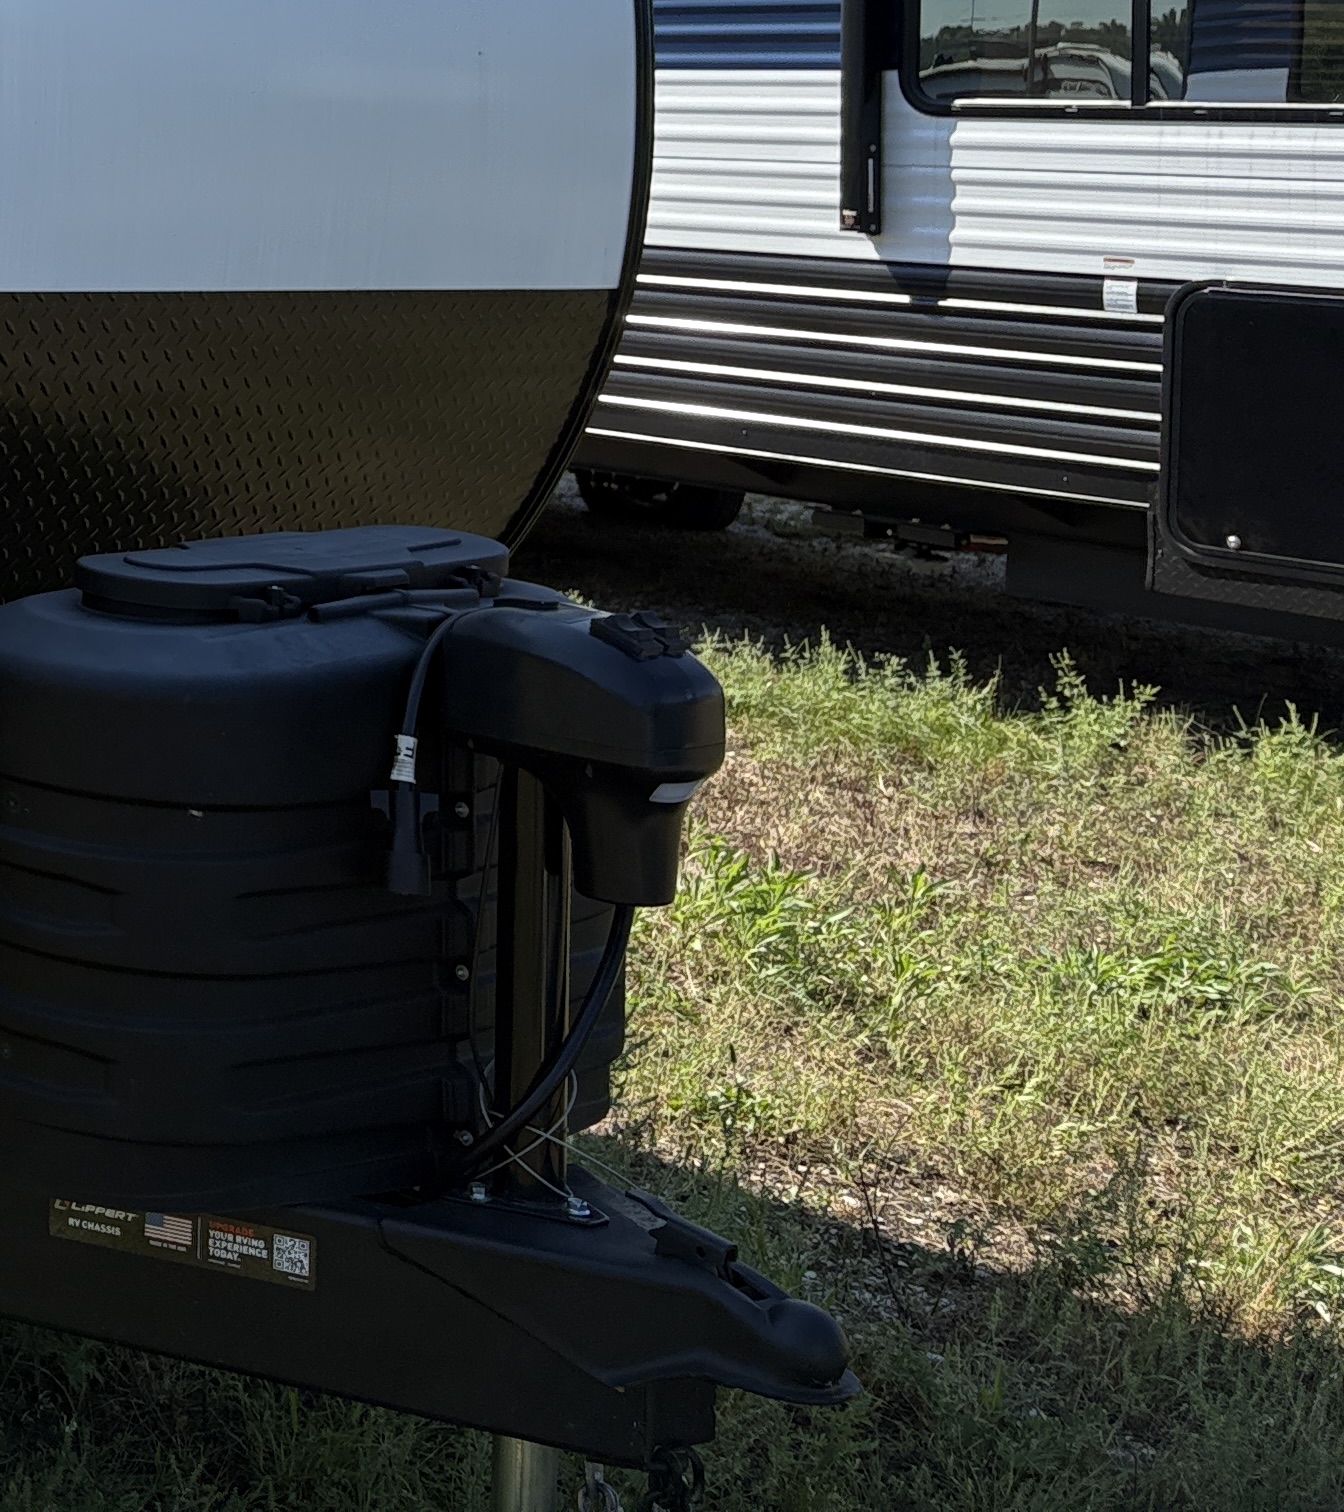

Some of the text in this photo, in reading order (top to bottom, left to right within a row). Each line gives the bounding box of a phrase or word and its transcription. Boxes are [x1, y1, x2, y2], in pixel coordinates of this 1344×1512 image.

[68, 1217, 121, 1236] RV CHASSIS
[208, 1229, 234, 1243] YOUR
[208, 1238, 268, 1259] EXPERIENCE
